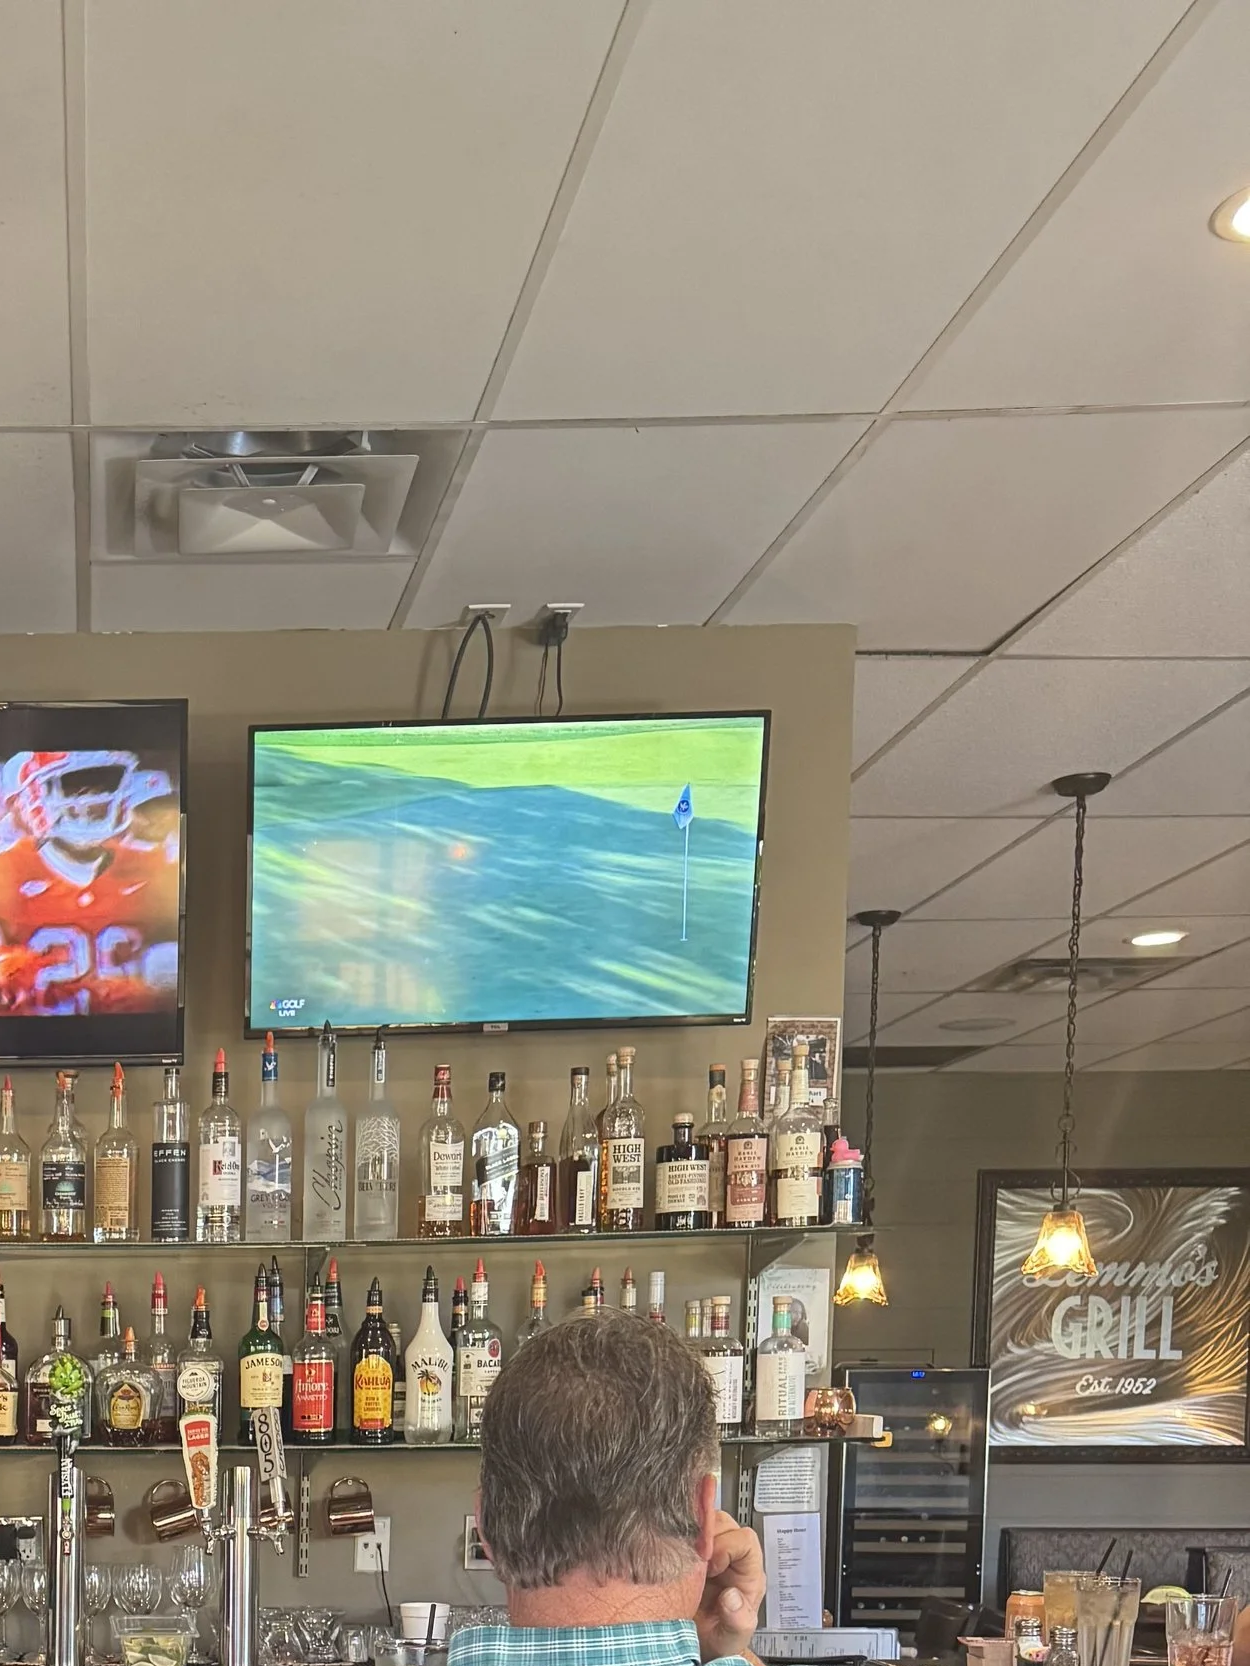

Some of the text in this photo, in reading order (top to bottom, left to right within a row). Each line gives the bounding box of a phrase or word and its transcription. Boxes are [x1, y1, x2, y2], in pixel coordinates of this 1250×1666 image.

[282, 999, 305, 1009] GOLF
[154, 1149, 187, 1157] EFFEN
[613, 1144, 641, 1154] HIGH
[613, 1154, 641, 1163] WEST
[312, 1120, 344, 1211] Chopin
[668, 1164, 688, 1172] HIGH
[1051, 1295, 1182, 1360] GRILL
[477, 1359, 501, 1368] BACAR
[1075, 1374, 1156, 1396] Est. 1952
[778, 1375, 787, 1416] RITUAL
[49, 1404, 72, 1418] Space
[59, 1411, 82, 1423] Dust
[258, 1413, 274, 1473] 805
[61, 1458, 73, 1496] ELYSIAN
